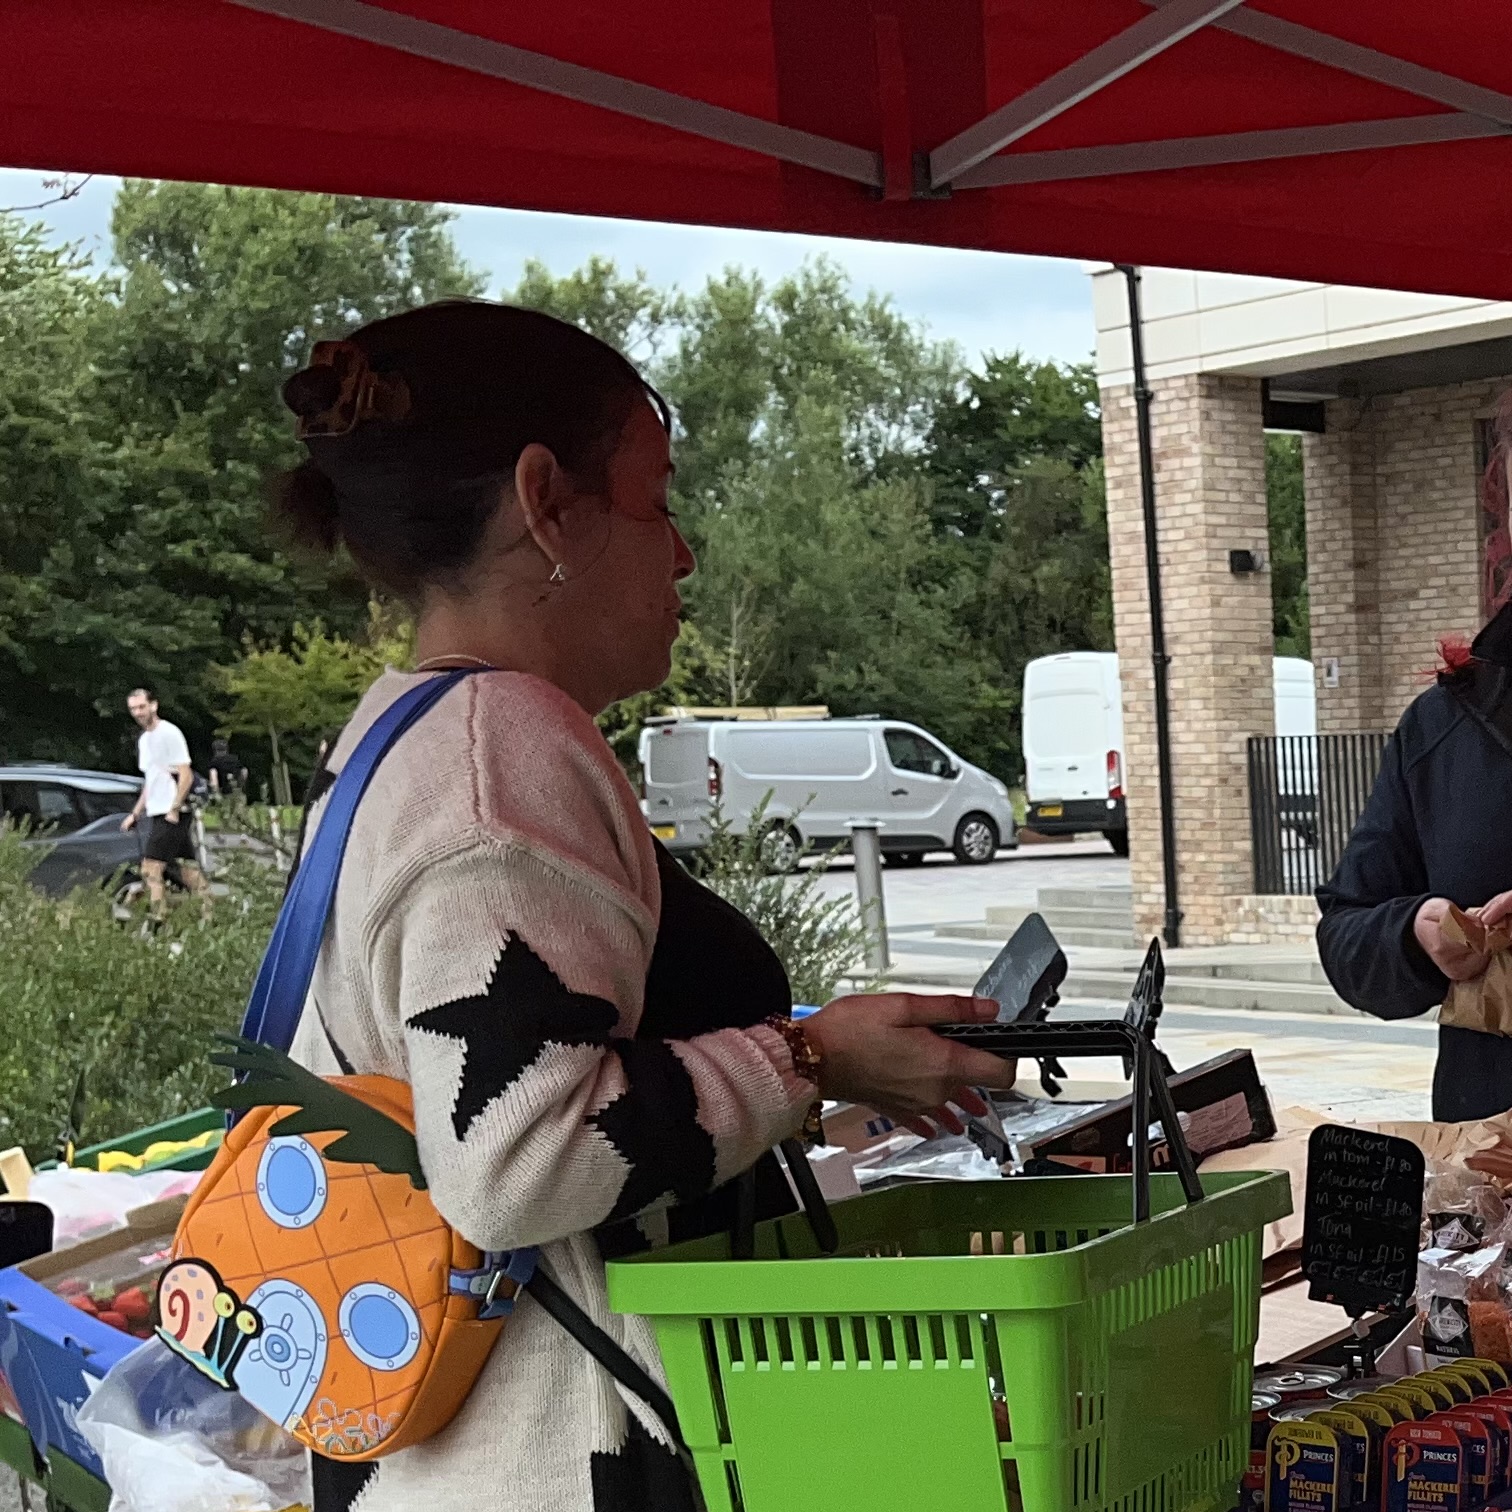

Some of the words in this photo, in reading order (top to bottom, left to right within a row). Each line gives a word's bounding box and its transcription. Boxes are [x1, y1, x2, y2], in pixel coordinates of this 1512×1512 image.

[1303, 1449, 1334, 1462] PRINCES
[1423, 1450, 1457, 1462] PRINCES
[1289, 1489, 1322, 1502] FILLETS
[1407, 1490, 1444, 1503] FILLETS
